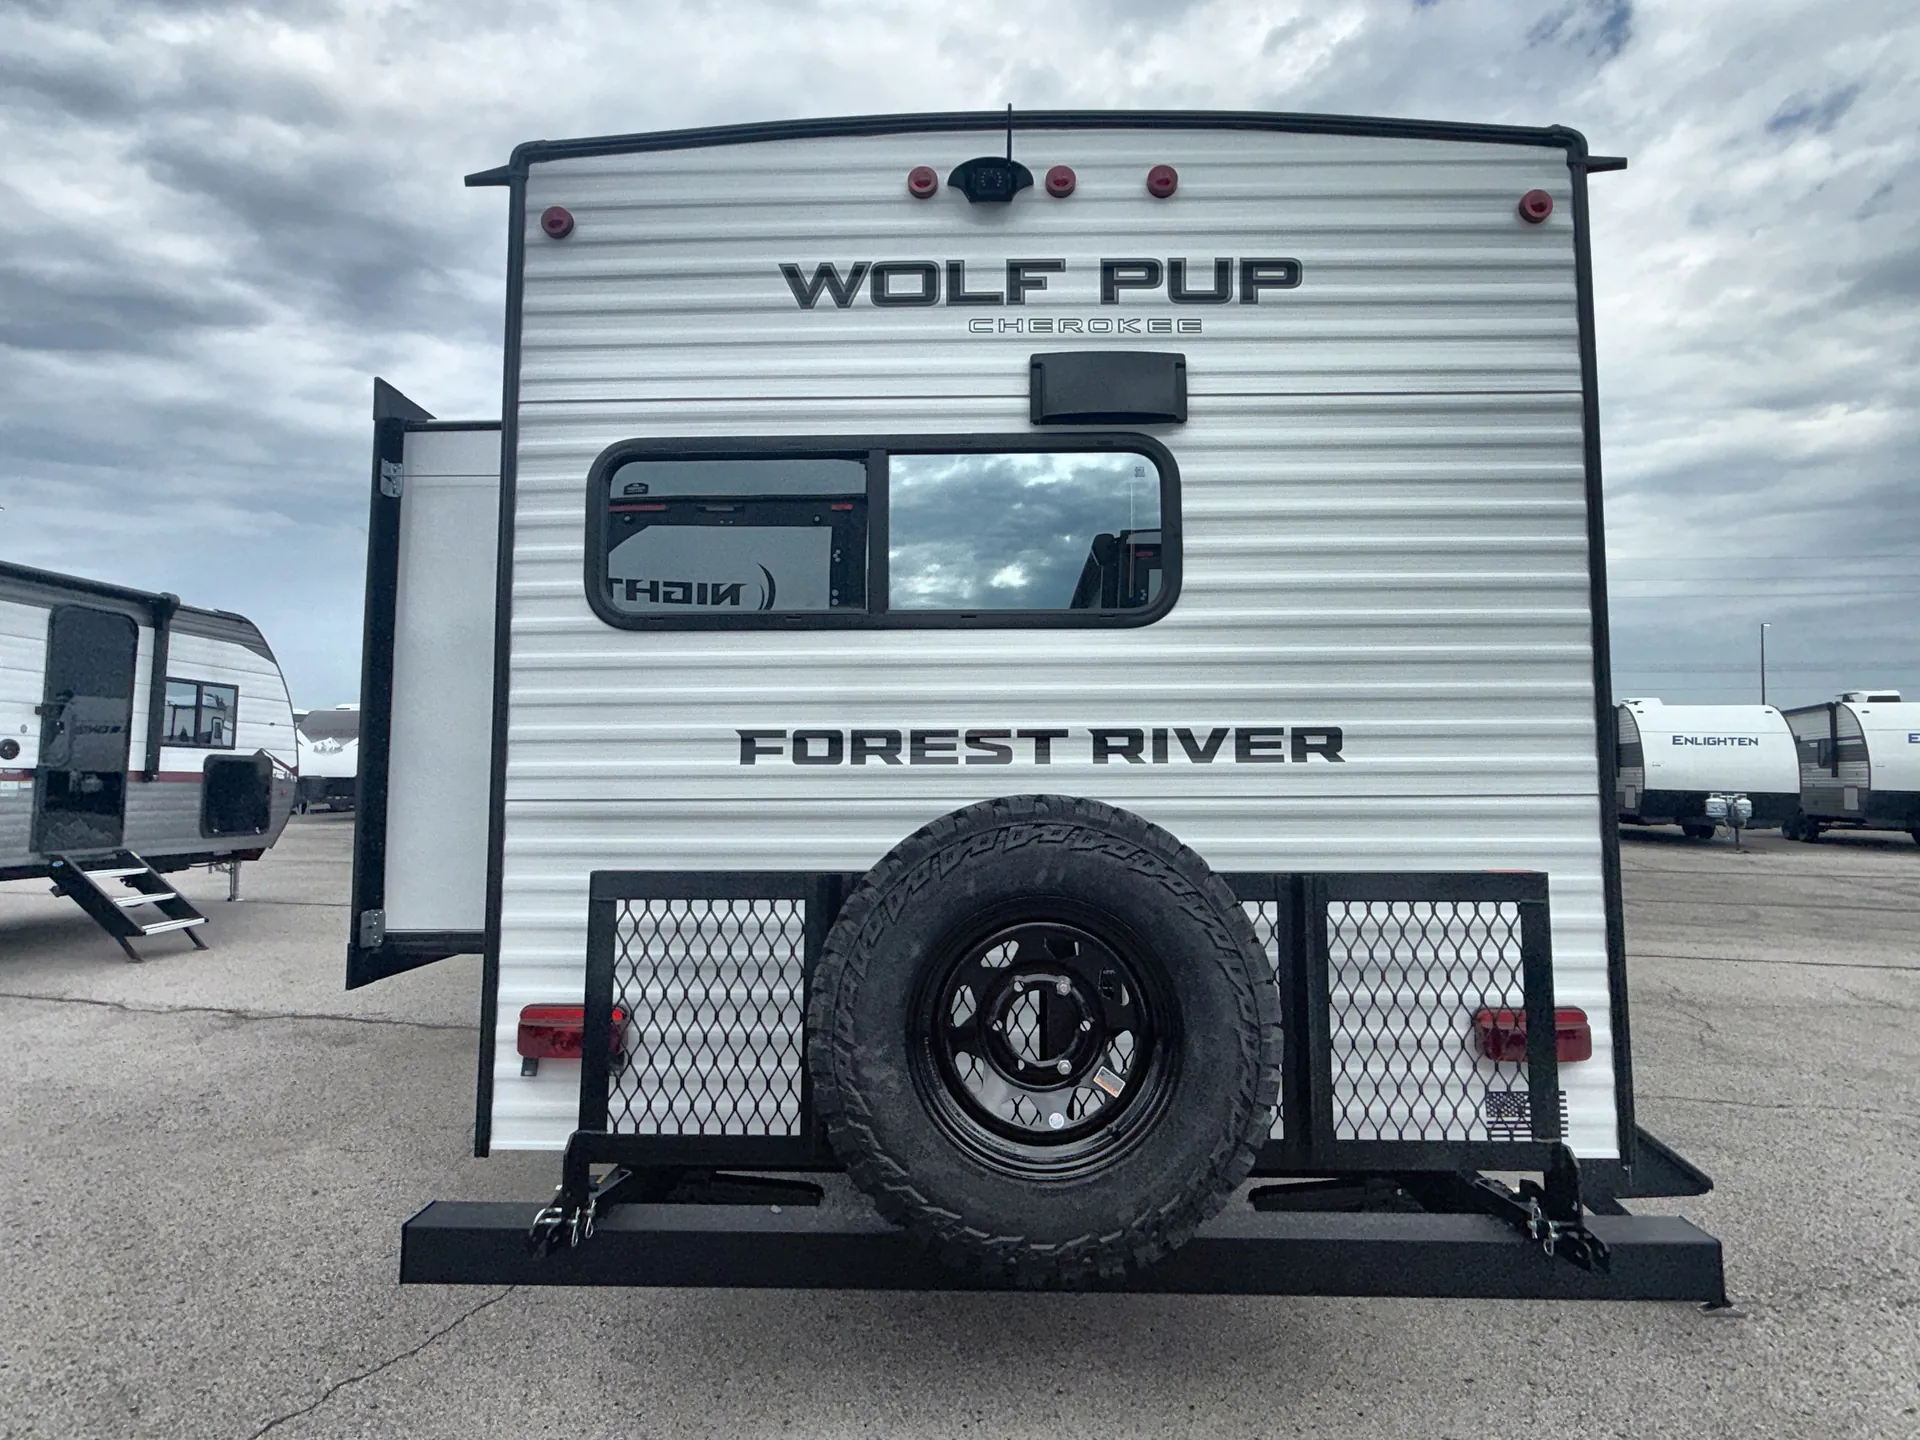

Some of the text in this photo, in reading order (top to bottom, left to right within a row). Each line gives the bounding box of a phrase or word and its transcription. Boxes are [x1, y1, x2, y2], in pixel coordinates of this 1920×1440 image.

[779, 257, 1302, 309] WOLF PUP
[968, 318, 1203, 334] CHEROKEE
[735, 727, 1346, 765] FOREST RIVER
